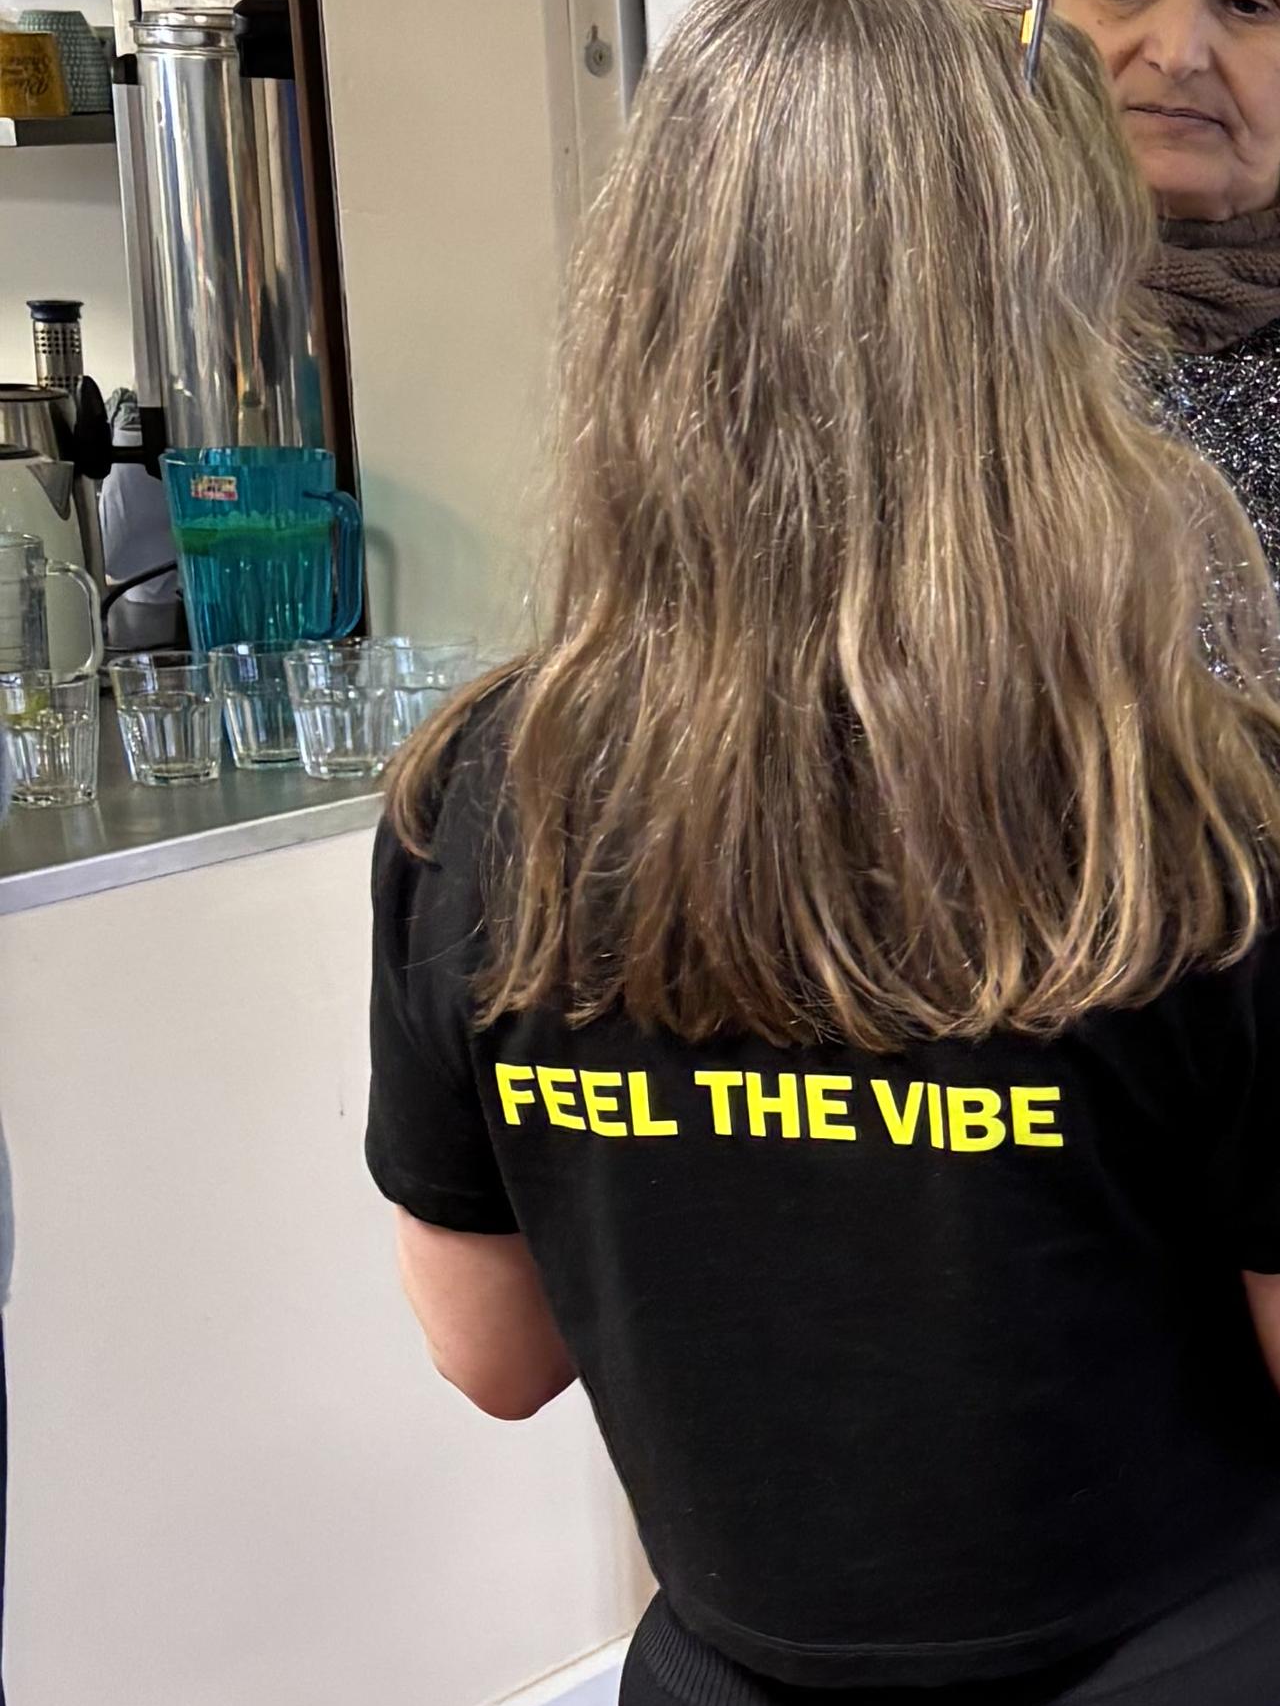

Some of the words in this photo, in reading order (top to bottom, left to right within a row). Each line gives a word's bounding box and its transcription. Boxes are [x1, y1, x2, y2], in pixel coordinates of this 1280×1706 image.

[495, 1063, 678, 1138] FEEL
[695, 1071, 857, 1142] THE
[870, 1079, 1064, 1153] VIBE
